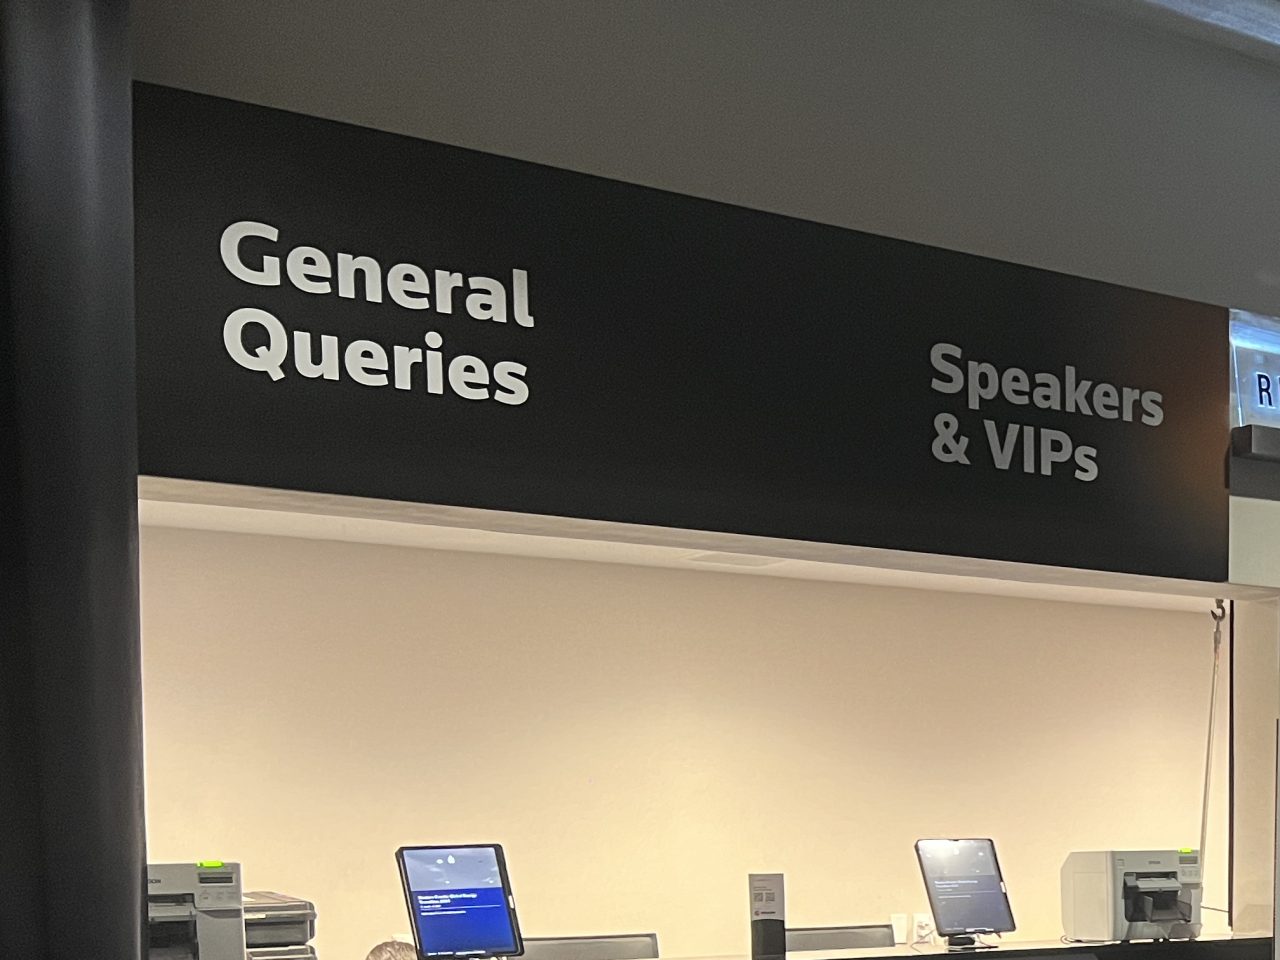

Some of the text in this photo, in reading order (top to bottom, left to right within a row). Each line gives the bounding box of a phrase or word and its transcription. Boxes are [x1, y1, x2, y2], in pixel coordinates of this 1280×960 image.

[219, 220, 534, 328] General
[222, 307, 530, 406] Queries
[930, 342, 1164, 427] Speakers
[931, 412, 1099, 482] & VIPs
